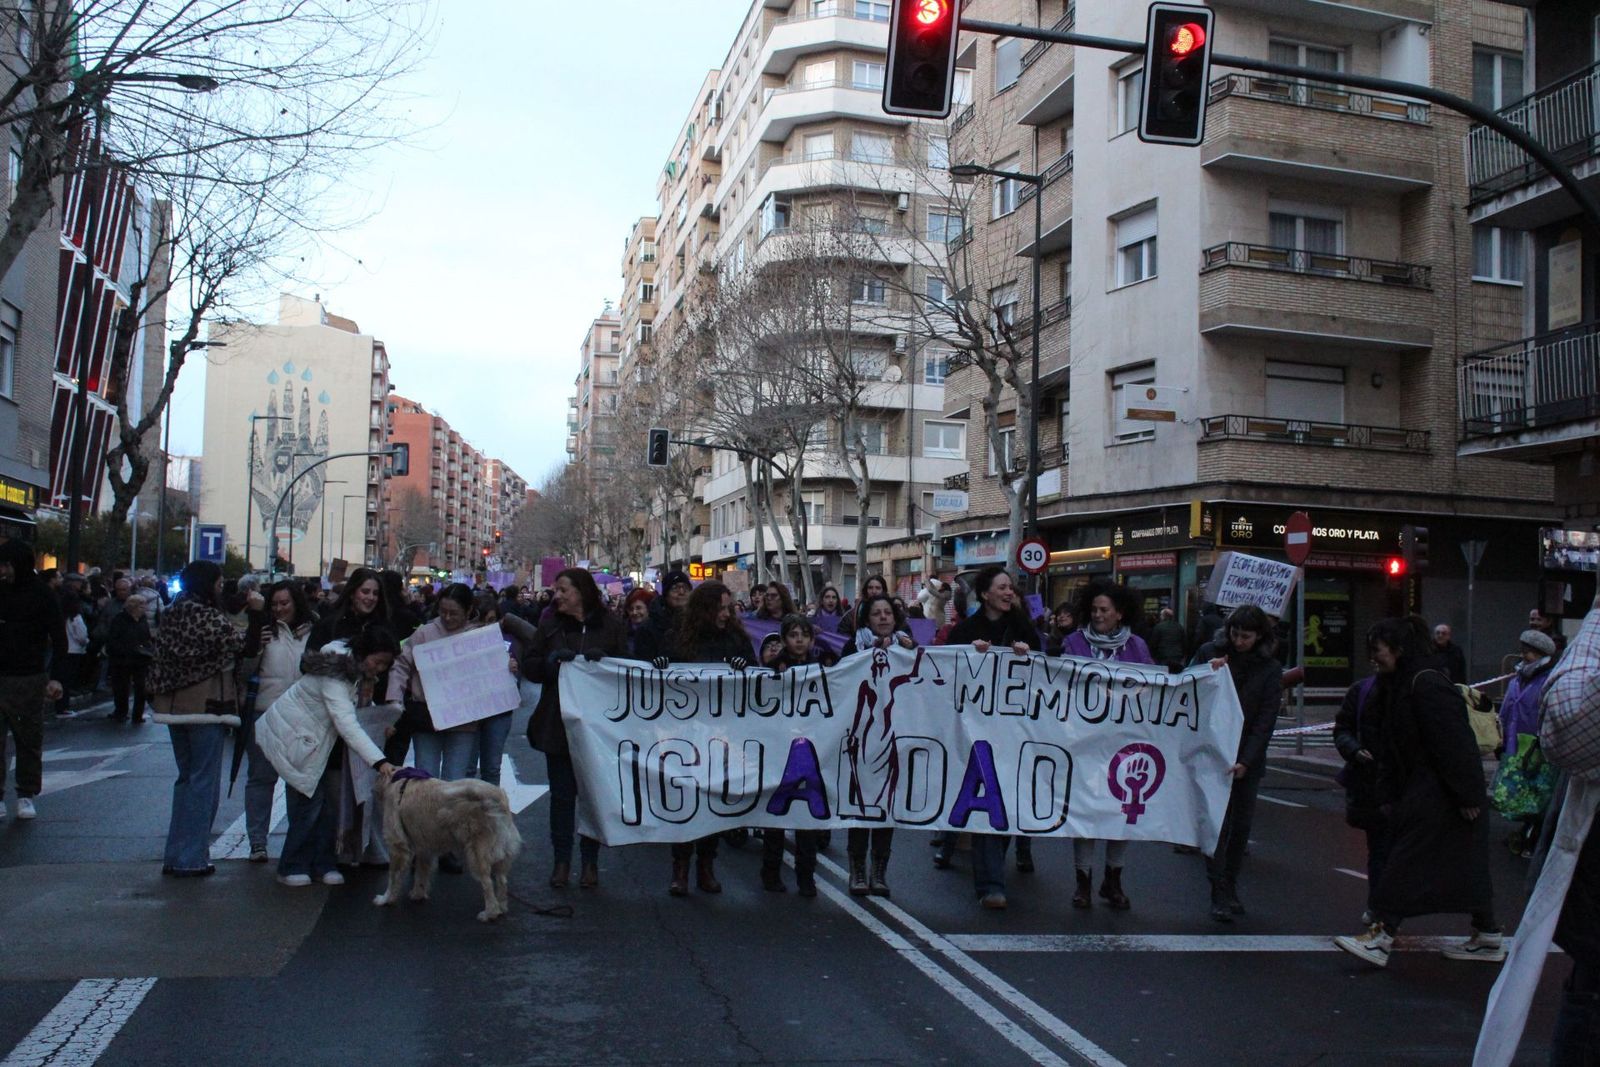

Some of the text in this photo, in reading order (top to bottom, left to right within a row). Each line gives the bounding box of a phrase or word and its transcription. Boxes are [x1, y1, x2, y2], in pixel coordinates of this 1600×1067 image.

[202, 532, 221, 555] T
[1230, 530, 1253, 539] ORO
[1327, 528, 1345, 539] ORO
[1346, 530, 1354, 540] Y
[1353, 530, 1380, 541] PLATA
[1023, 550, 1043, 561] 30
[604, 663, 834, 721] JUSTICIA
[953, 651, 1199, 731] MEMORIA
[617, 735, 1073, 833] IGUALDAD
